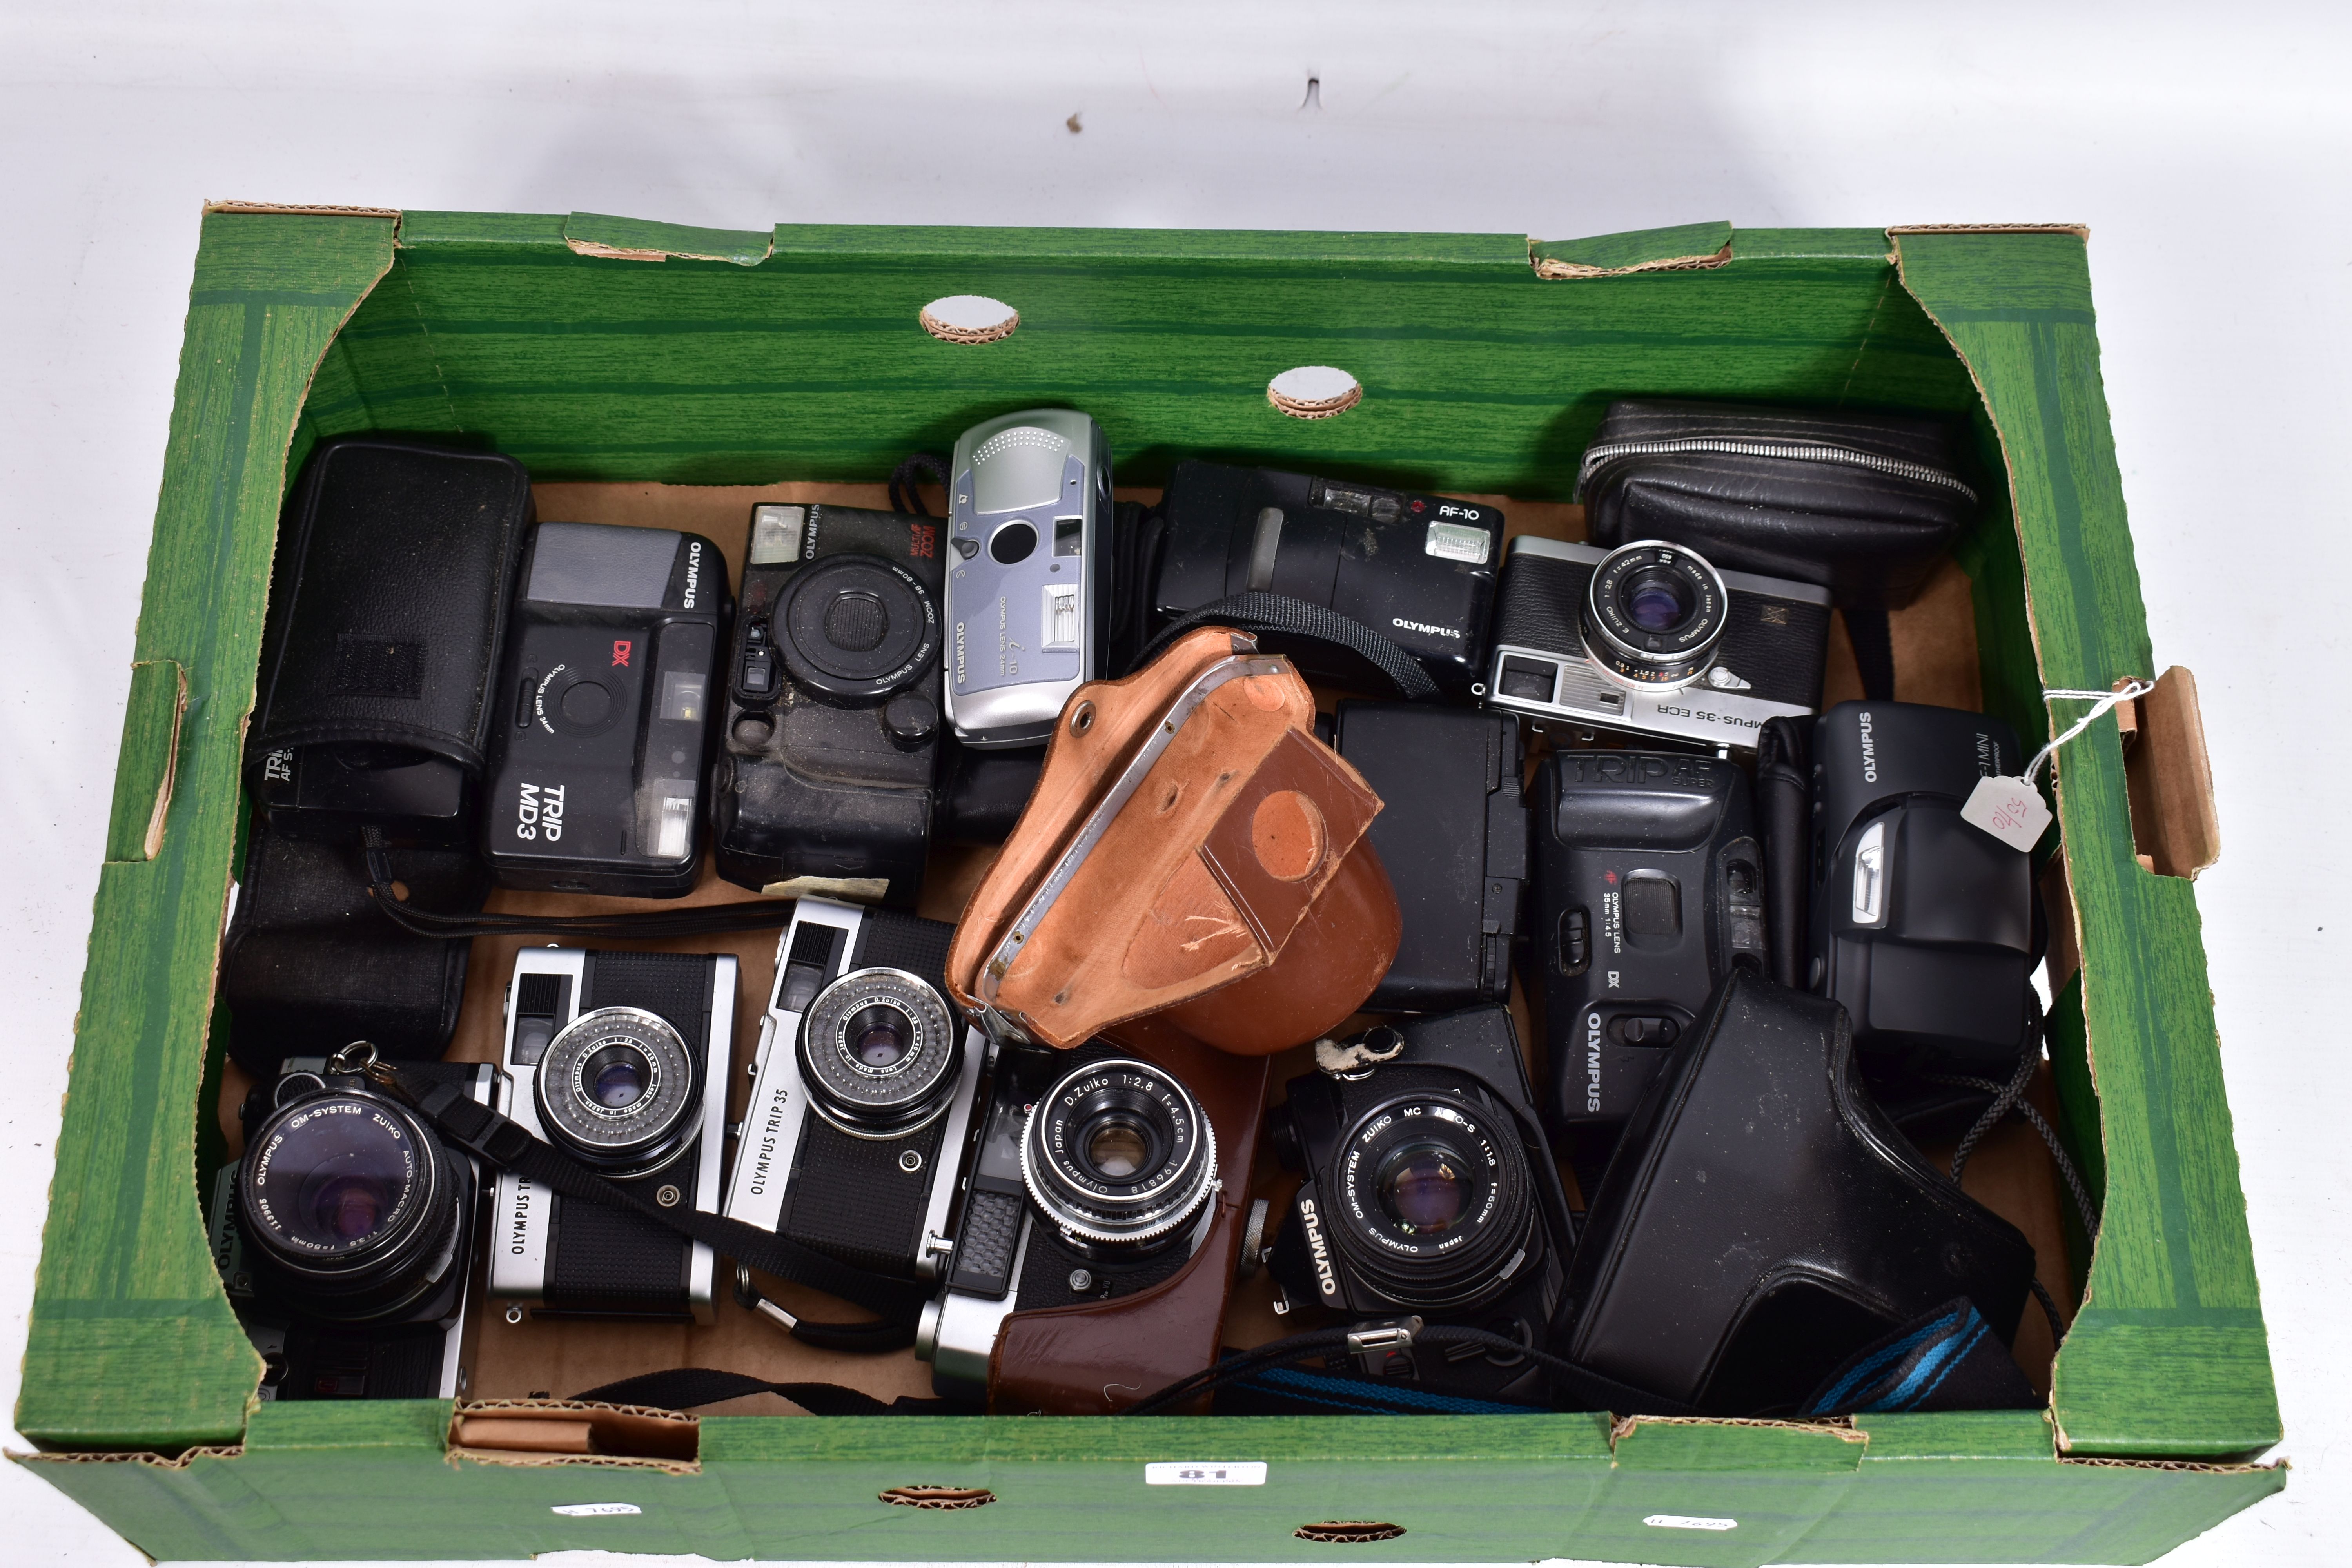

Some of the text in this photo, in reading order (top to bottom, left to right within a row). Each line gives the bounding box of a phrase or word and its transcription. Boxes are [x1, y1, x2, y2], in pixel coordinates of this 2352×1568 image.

[1439, 505, 1479, 520] AF-10
[805, 504, 820, 559] OLYMPUS
[920, 526, 936, 558] ZOOM
[684, 542, 701, 609] OLYMPUS
[1613, 555, 1642, 574] f=42mm
[1687, 565, 1702, 580] made
[1392, 618, 1461, 639] OLYMPUS
[1679, 619, 1708, 642] OLYMPUS
[612, 640, 631, 667] DX
[876, 664, 913, 685] OLYMPUS
[915, 642, 929, 662] LENS
[924, 601, 934, 624] ZOOM
[956, 622, 965, 684] OLYMPUS
[538, 664, 565, 694] OLYMPUS
[1657, 704, 1690, 718] ECR
[539, 716, 555, 734] 34mm
[1859, 711, 1877, 782] OLYMPUS
[1976, 733, 1991, 760] MINI
[281, 747, 294, 782] AF S-
[1567, 755, 1712, 784] TRIP AF
[1671, 777, 1715, 789] SUPER
[517, 783, 540, 841] MD3
[542, 785, 565, 842] TRIP
[1612, 892, 1620, 929] OLYMPUS
[1608, 971, 1619, 988] DX
[843, 1000, 868, 1021] Olympus
[874, 997, 900, 1007] D.Zuiko
[582, 1040, 606, 1058] D.Zuiko
[845, 1054, 852, 1062] in
[1587, 1013, 1601, 1112] OLYMPUS
[855, 1063, 873, 1073] made
[646, 1084, 657, 1098] Lens
[1064, 1078, 1109, 1106] D.Zuiko
[1123, 1074, 1153, 1091] 1:2.8
[585, 1100, 604, 1114] Japan
[624, 1102, 642, 1113] made
[1403, 1107, 1421, 1117] MC
[751, 1089, 788, 1195] OLYMPUS TRIP 35
[1055, 1120, 1064, 1154] Japan
[1362, 1116, 1392, 1143] ZUIKO
[1481, 1140, 1496, 1167] 1:1.8
[258, 1105, 414, 1250] OLYMPUS OM-SYSTEM ZUIKO AUTO-MACRO 1:3.5 f=50mm 113905
[1063, 1160, 1108, 1193] Olympus
[1131, 1161, 1178, 1194] 196818
[1347, 1150, 1363, 1219] OM-SYSTEM
[1477, 1182, 1498, 1223] f=50mm
[511, 1195, 530, 1254] OLYMPUS
[1145, 1219, 1157, 1228] Film
[1158, 1210, 1174, 1223] Speed
[1301, 1199, 1336, 1295] OLYMPUS
[1369, 1227, 1418, 1253] OLYMPUS
[1439, 1235, 1463, 1249] Japan
[1100, 1280, 1111, 1299] Pre-VU
[1179, 1470, 1227, 1479] 81
